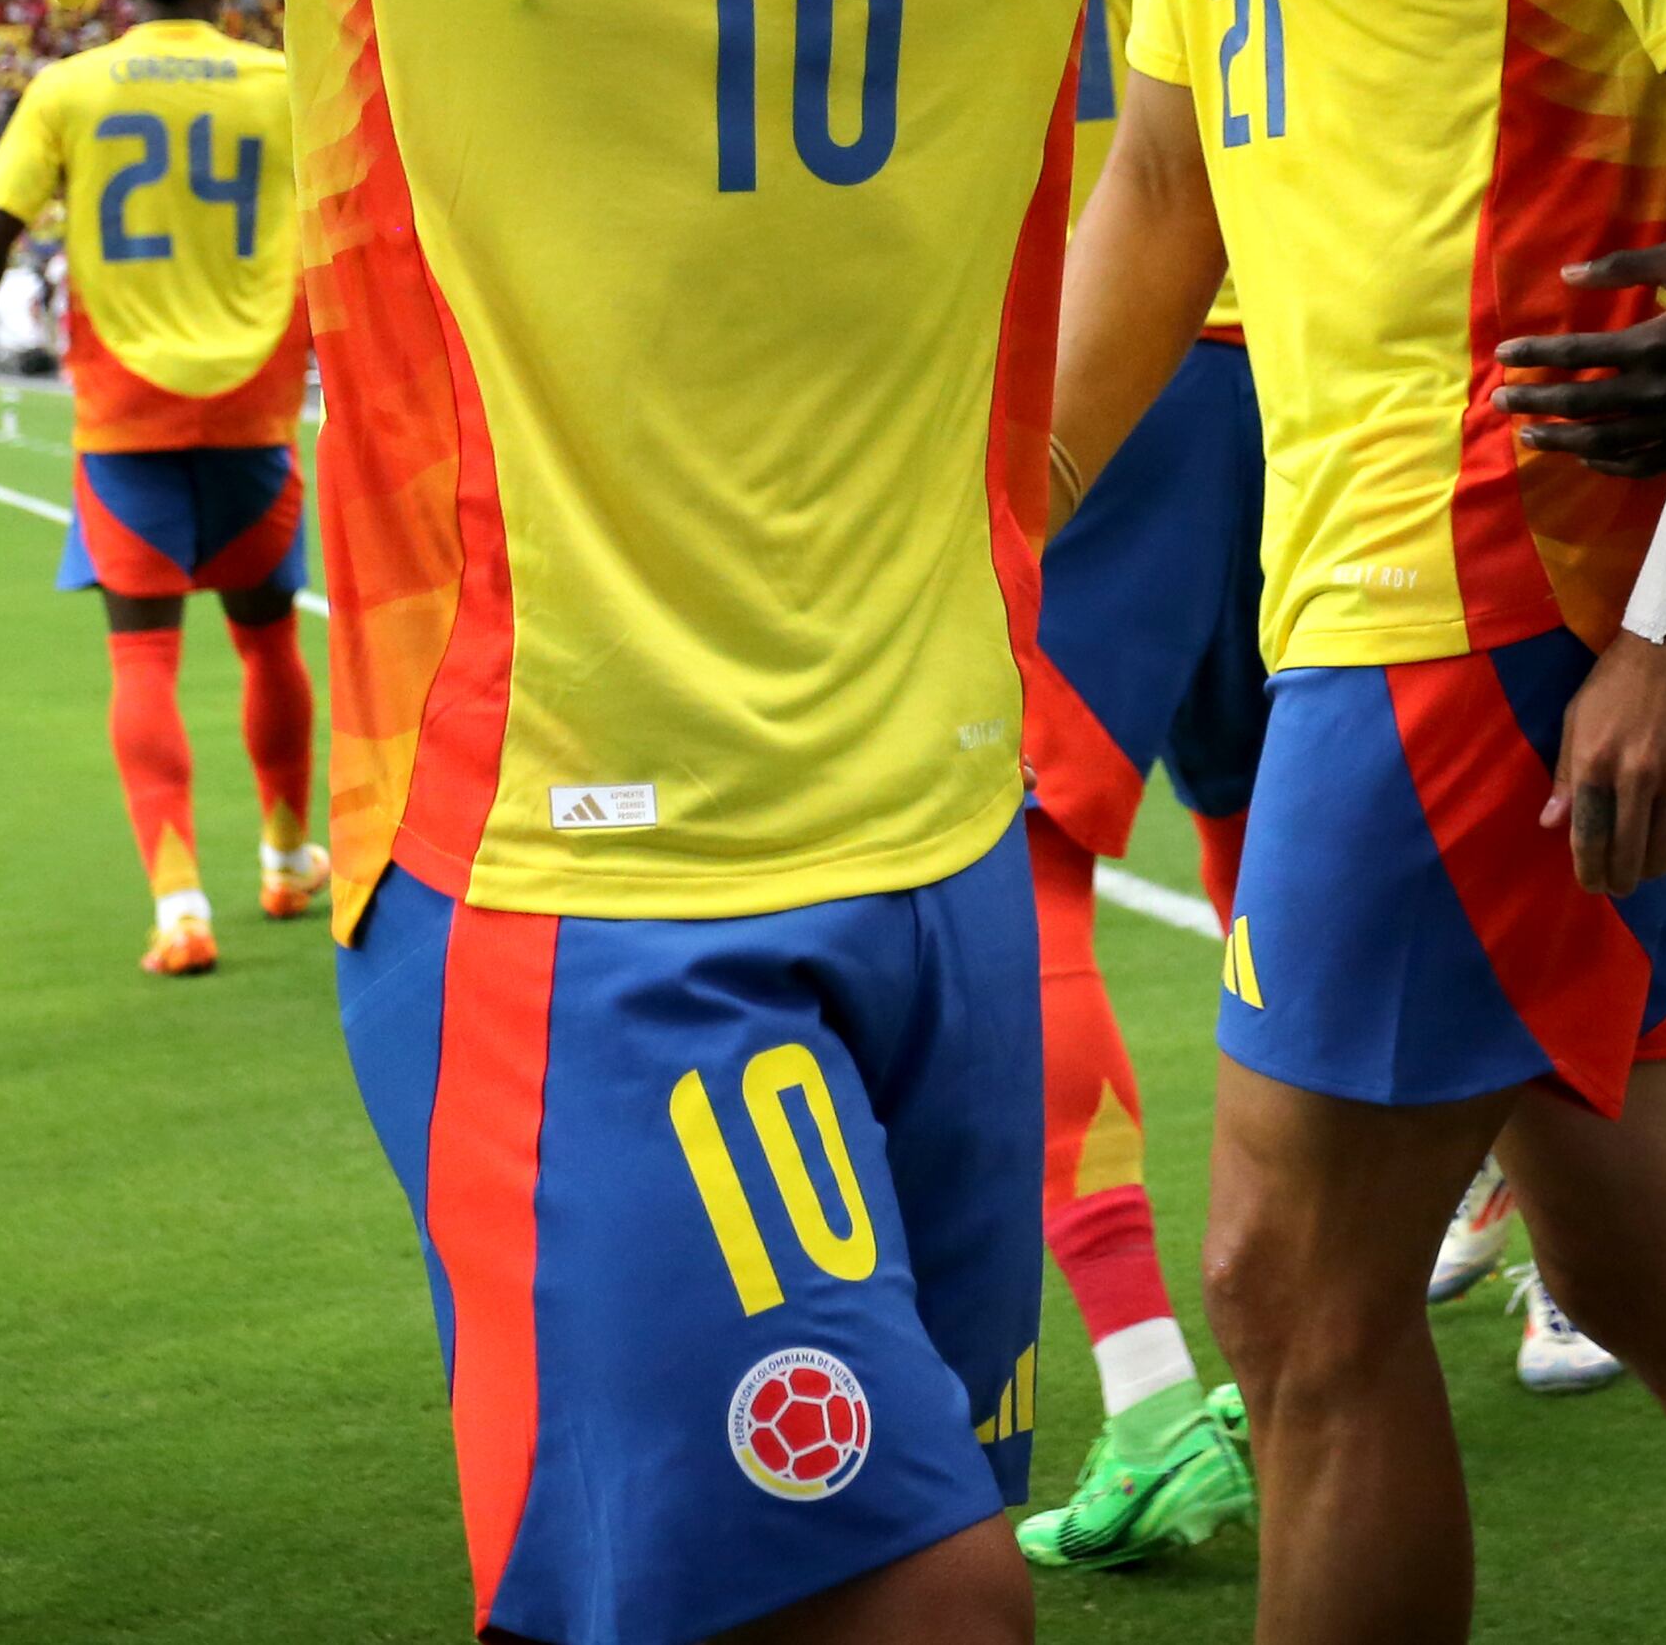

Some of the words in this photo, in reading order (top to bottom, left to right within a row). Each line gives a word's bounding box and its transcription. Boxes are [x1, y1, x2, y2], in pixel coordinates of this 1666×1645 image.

[95, 111, 263, 264] 24
[669, 1042, 877, 1318] 10
[753, 1353, 815, 1384] COLOMBIANA
[817, 1356, 828, 1369] DE
